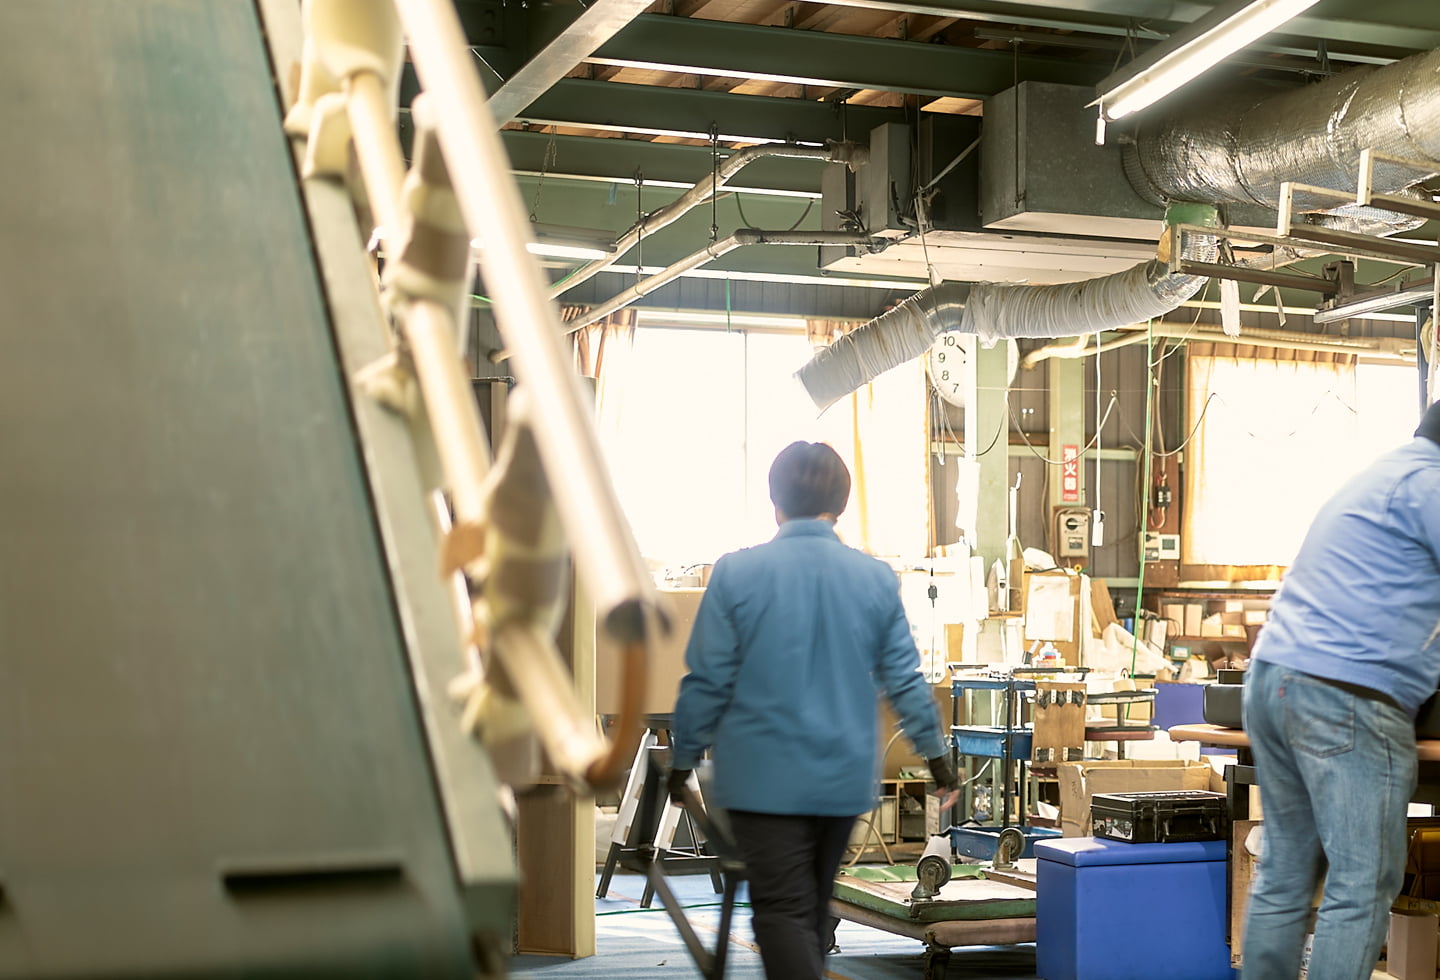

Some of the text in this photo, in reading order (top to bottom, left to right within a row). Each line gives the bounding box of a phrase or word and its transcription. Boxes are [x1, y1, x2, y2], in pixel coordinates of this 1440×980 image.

[943, 336, 955, 347] 10
[938, 352, 946, 363] 9
[941, 370, 950, 381] 8
[952, 383, 960, 394] 7
